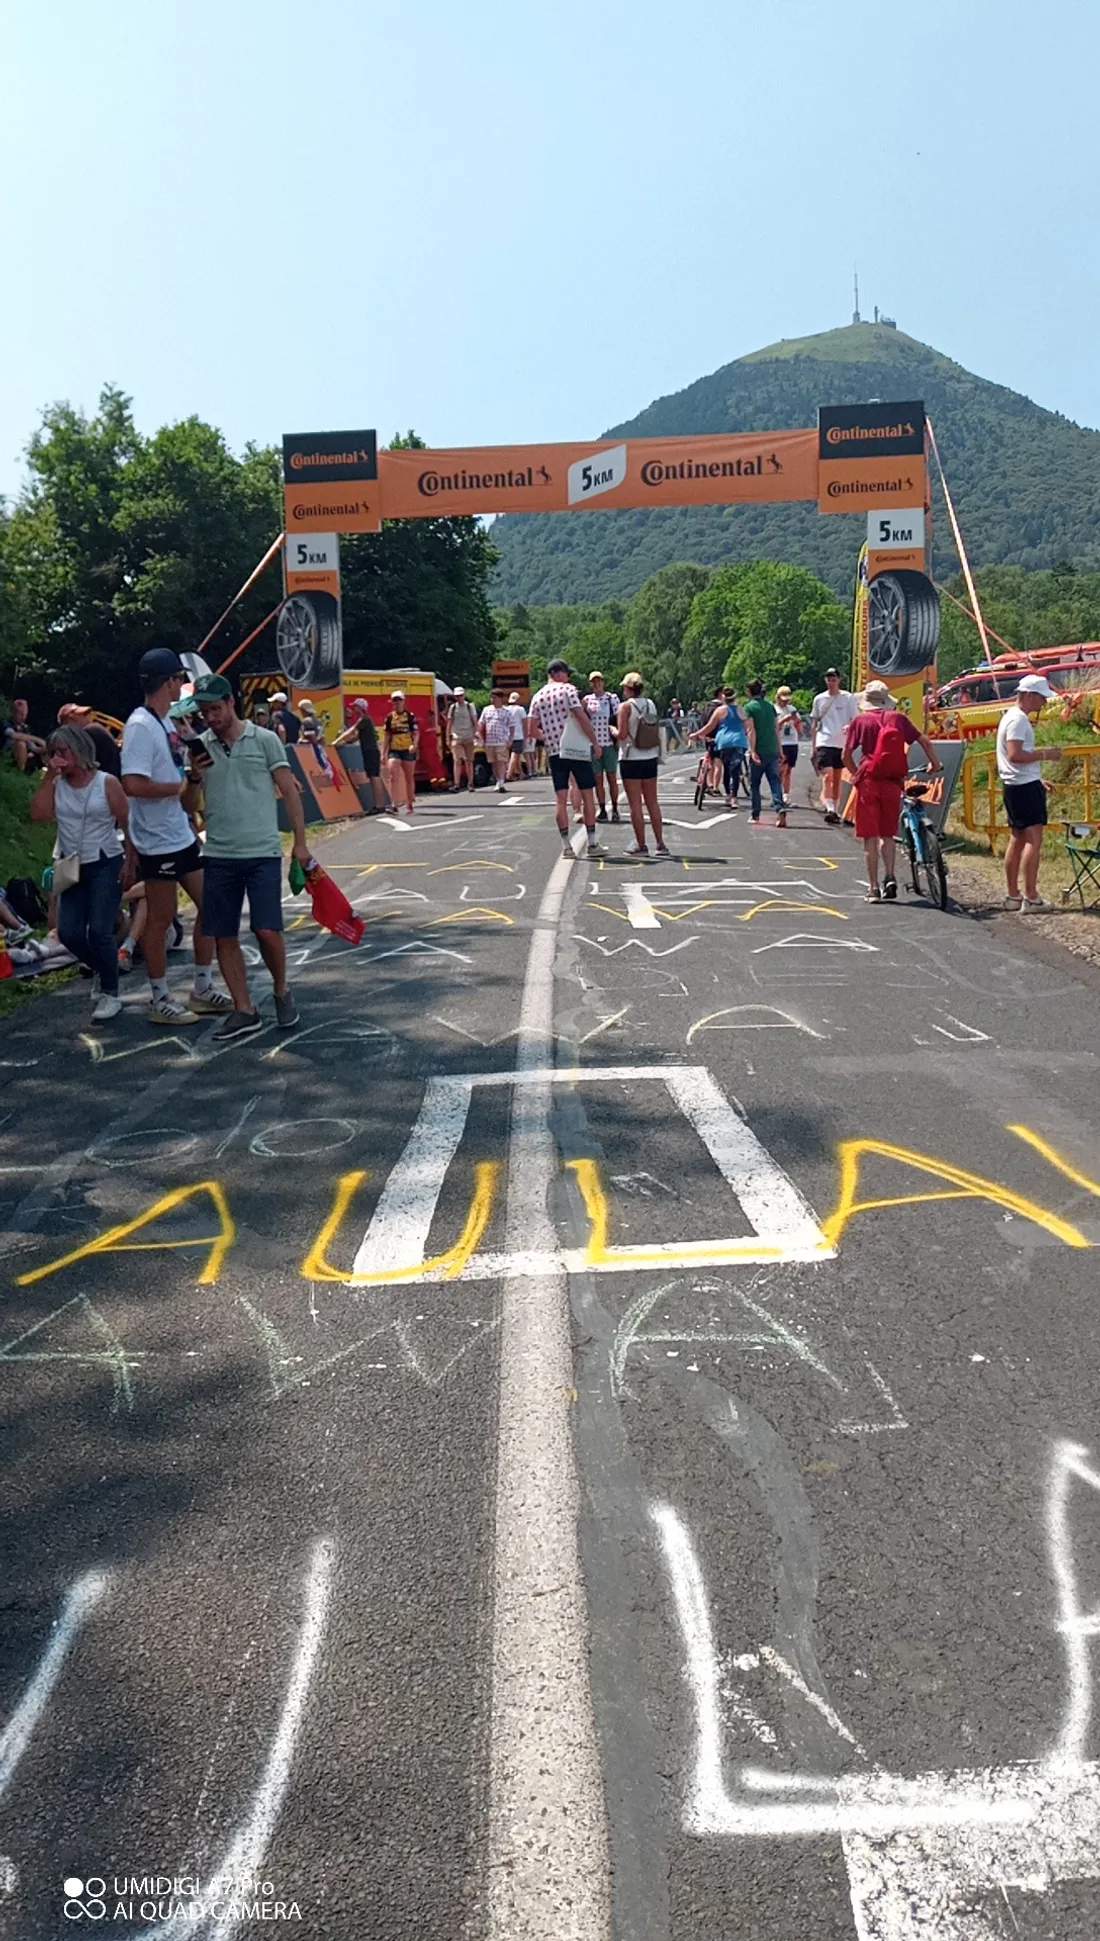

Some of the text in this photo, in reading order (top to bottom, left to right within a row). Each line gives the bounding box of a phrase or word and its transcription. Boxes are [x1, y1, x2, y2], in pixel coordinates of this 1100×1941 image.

[826, 424, 902, 444] Continental
[290, 450, 359, 469] Continental
[641, 455, 762, 486] Continental
[417, 467, 533, 497] Continental
[827, 478, 903, 497] Continental
[292, 502, 360, 520] Continental
